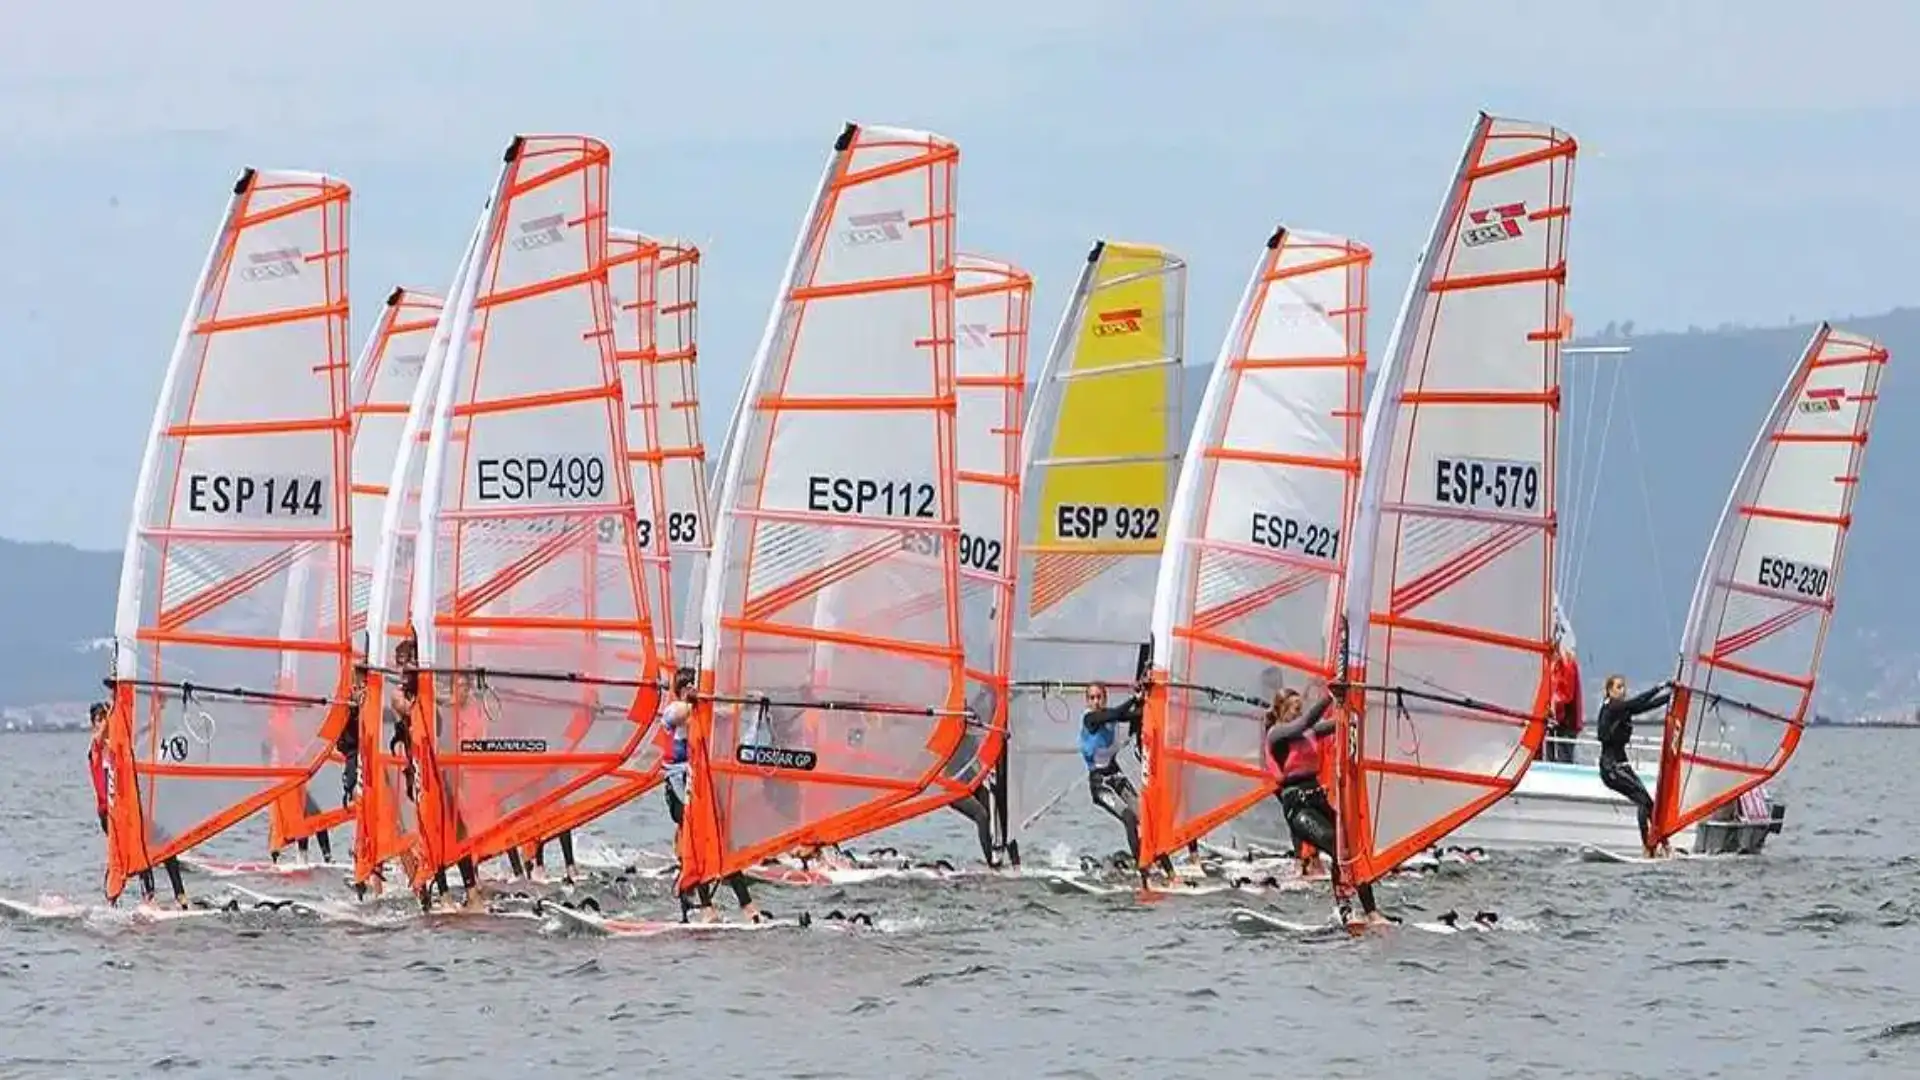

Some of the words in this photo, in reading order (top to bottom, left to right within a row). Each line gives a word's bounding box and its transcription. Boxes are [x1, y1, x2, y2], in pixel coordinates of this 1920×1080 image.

[479, 458, 605, 499] ESP499
[808, 476, 936, 517] ESP112
[1436, 460, 1538, 508] ESP-579
[1058, 505, 1108, 539] ESP
[1115, 507, 1160, 539] 932
[1252, 512, 1341, 560] ESP-221
[959, 533, 1001, 572] 902
[1758, 556, 1829, 597] ESP-230
